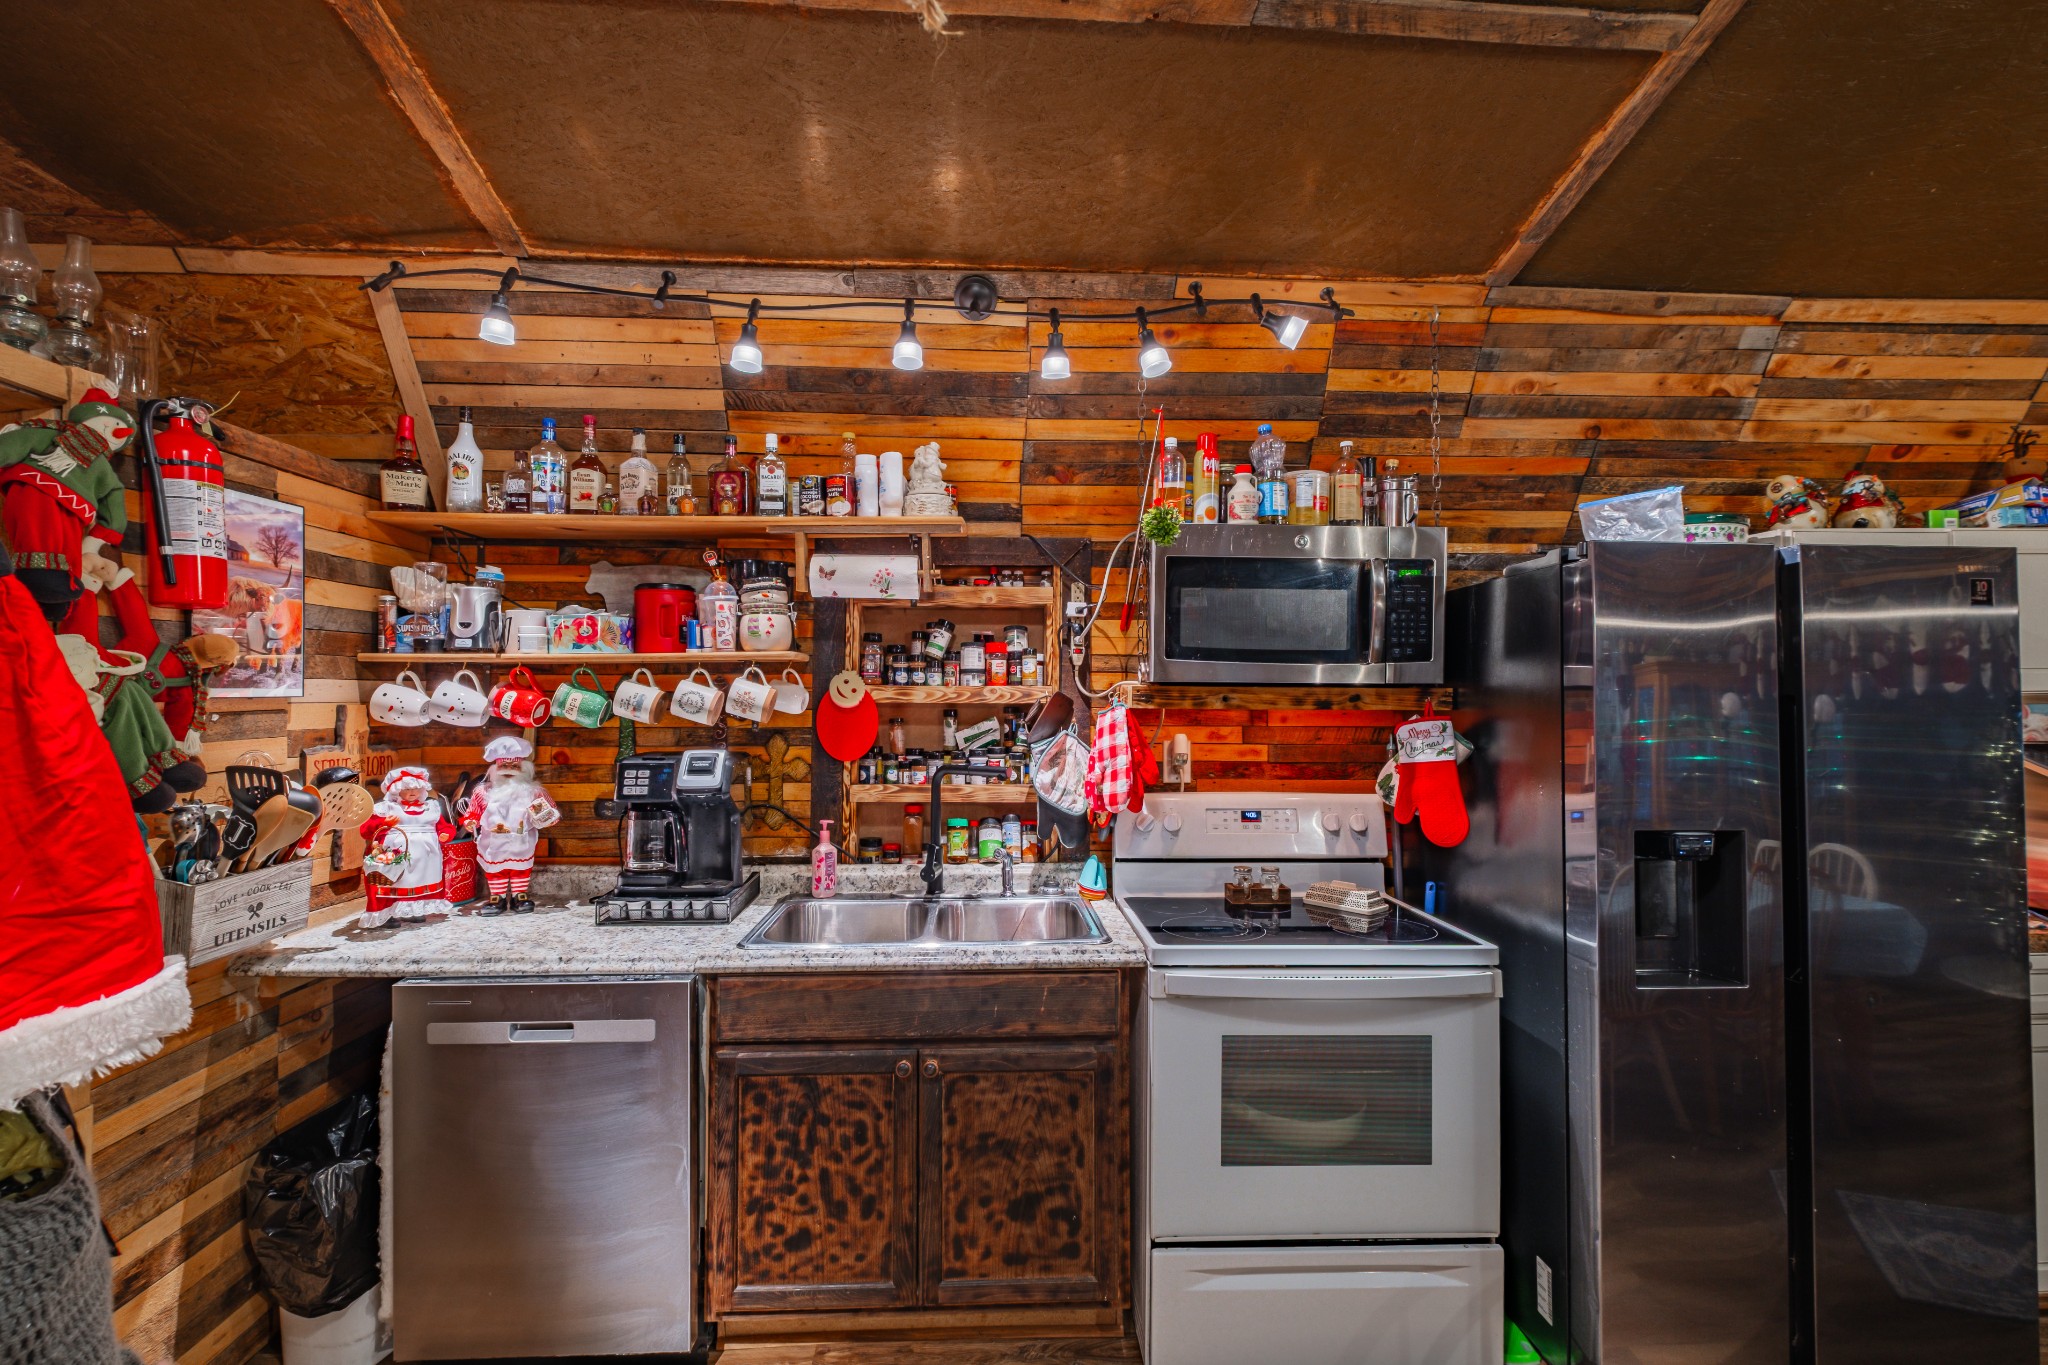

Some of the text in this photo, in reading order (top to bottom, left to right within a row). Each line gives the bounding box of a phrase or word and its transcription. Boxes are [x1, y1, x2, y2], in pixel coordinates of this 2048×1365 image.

[448, 452, 476, 464] MALIBU
[1991, 513, 2003, 523] 65
[1976, 581, 1988, 592] 10
[502, 694, 513, 716] Nana
[565, 697, 578, 716] Papa
[1403, 726, 1431, 740] Merry
[366, 755, 393, 776] LORD
[229, 821, 248, 842] J
[214, 894, 238, 912] LOVE
[247, 884, 272, 896] COOK
[214, 913, 287, 947] UTENSILS
